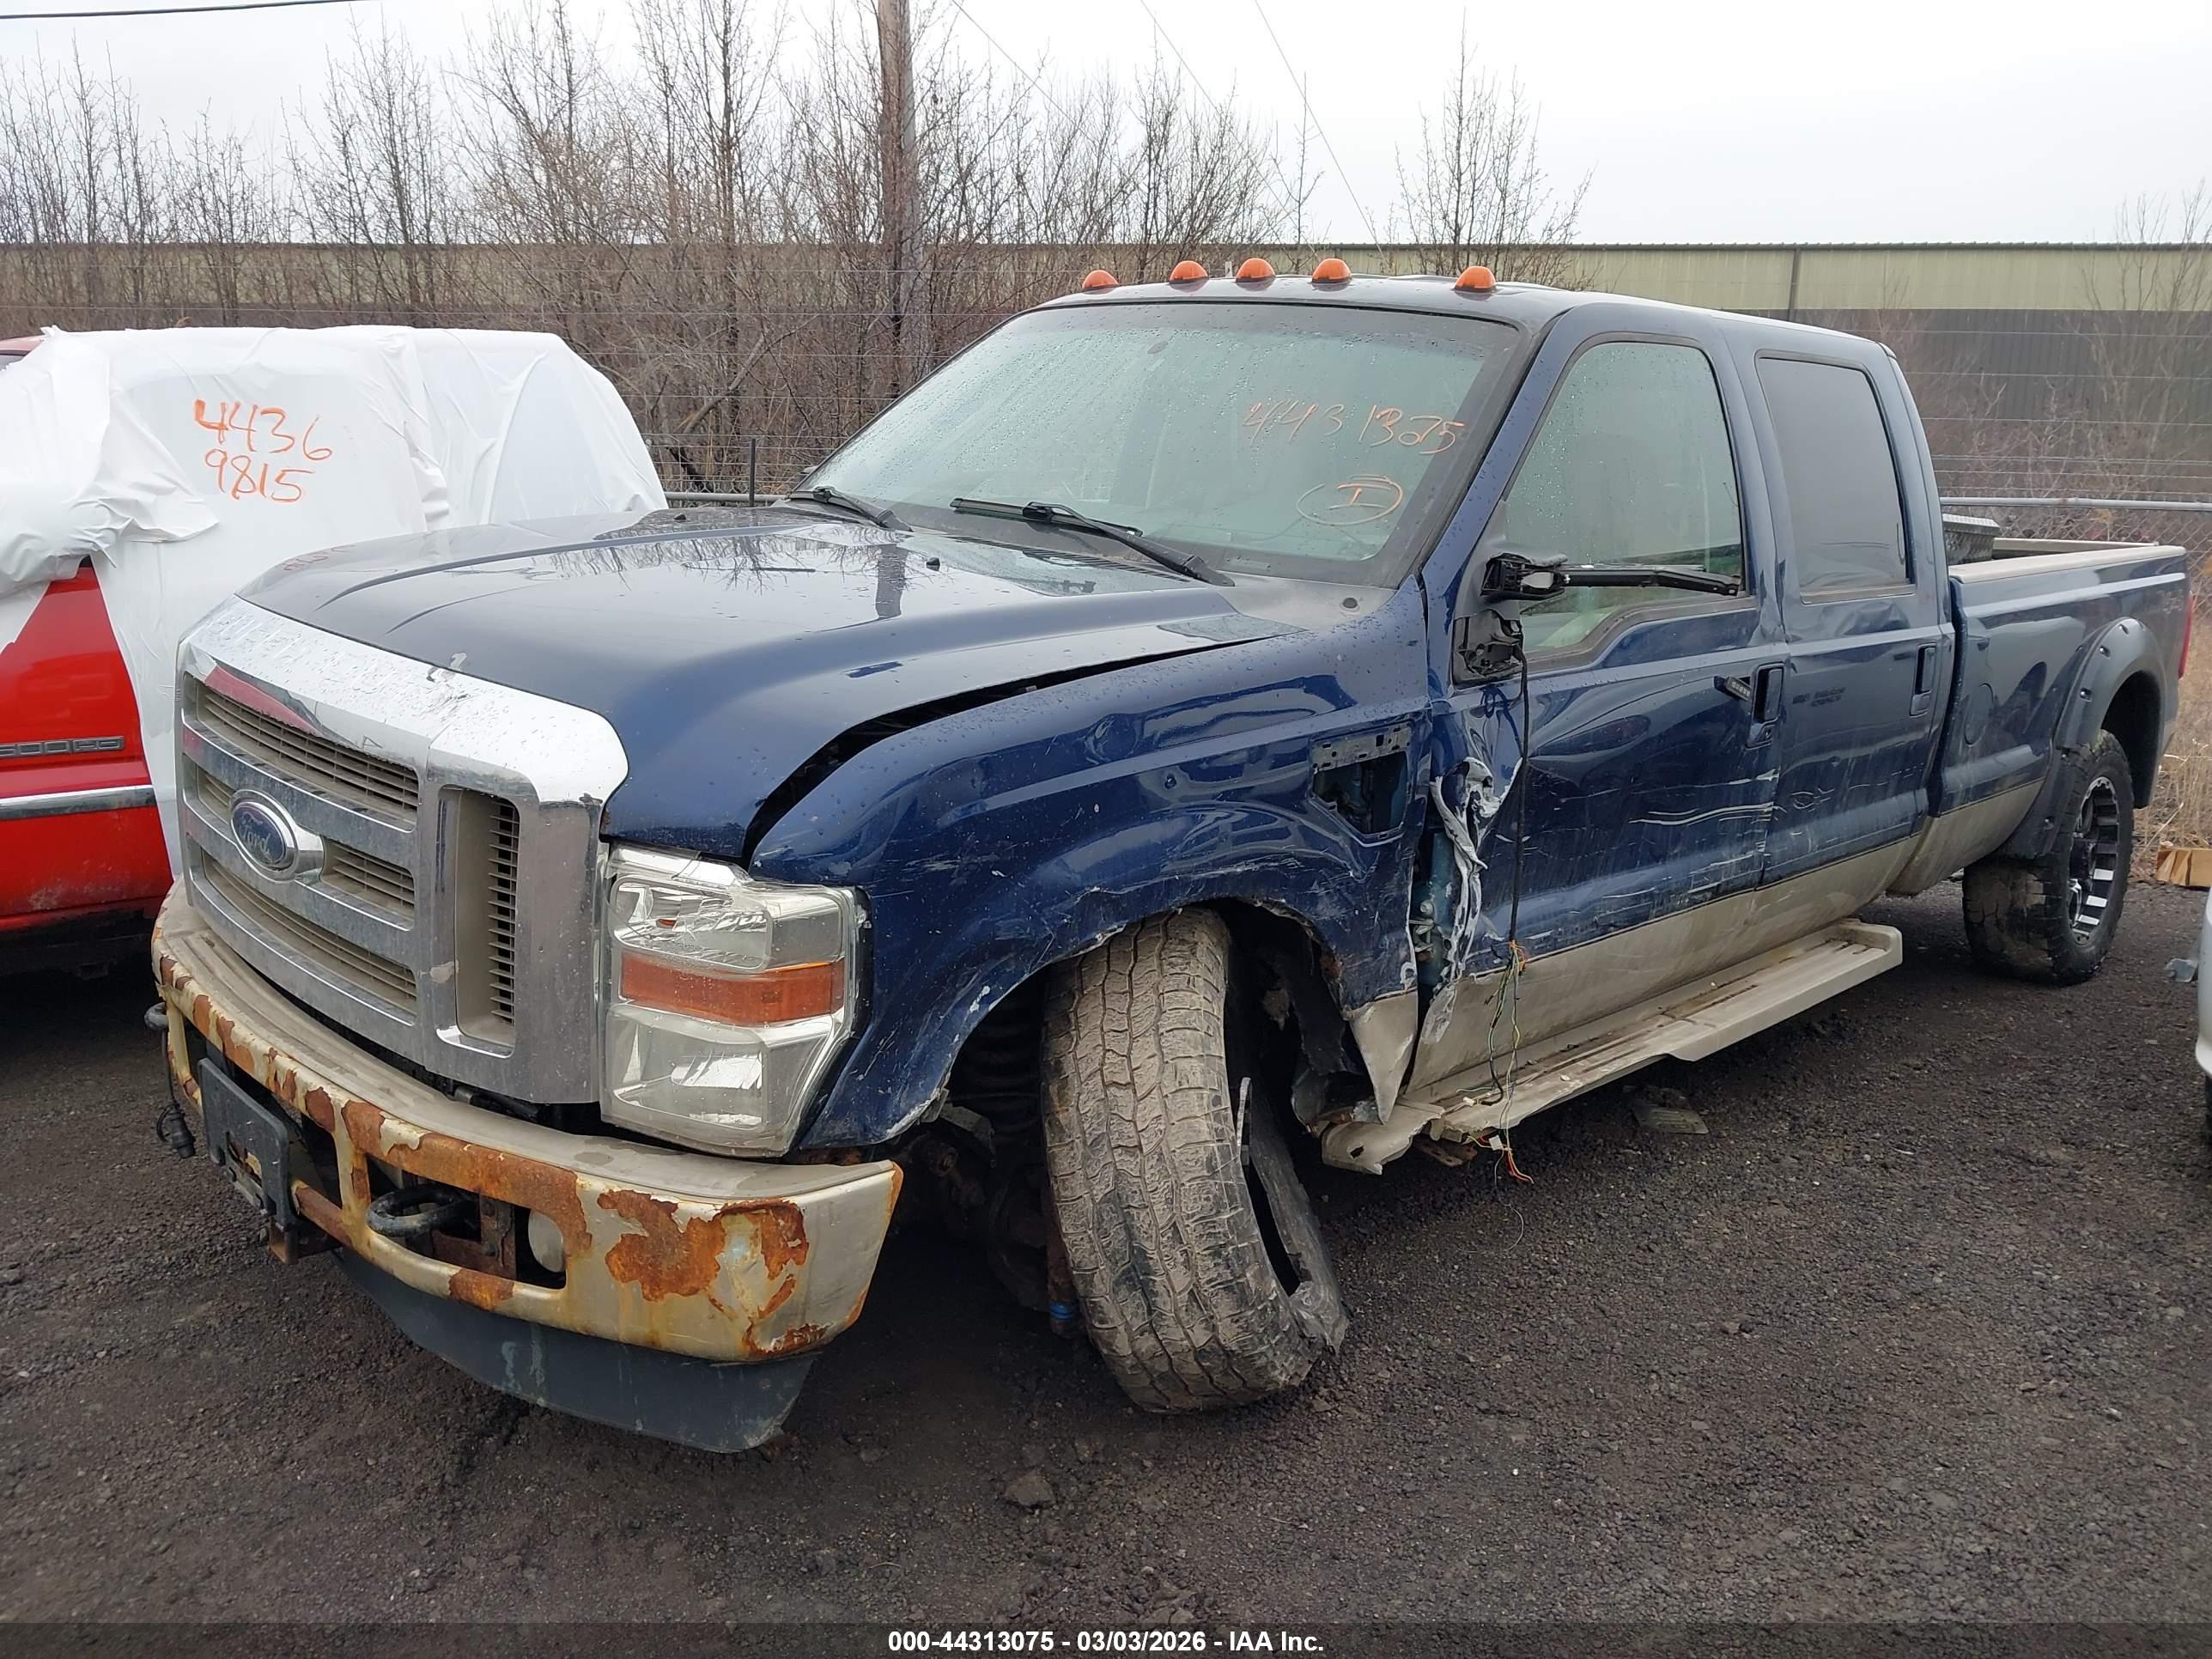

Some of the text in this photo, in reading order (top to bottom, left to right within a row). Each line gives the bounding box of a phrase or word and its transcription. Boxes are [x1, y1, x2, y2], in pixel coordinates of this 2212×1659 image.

[193, 398, 333, 461] 4436
[204, 448, 316, 502] 9815
[239, 810, 275, 862] Ford
